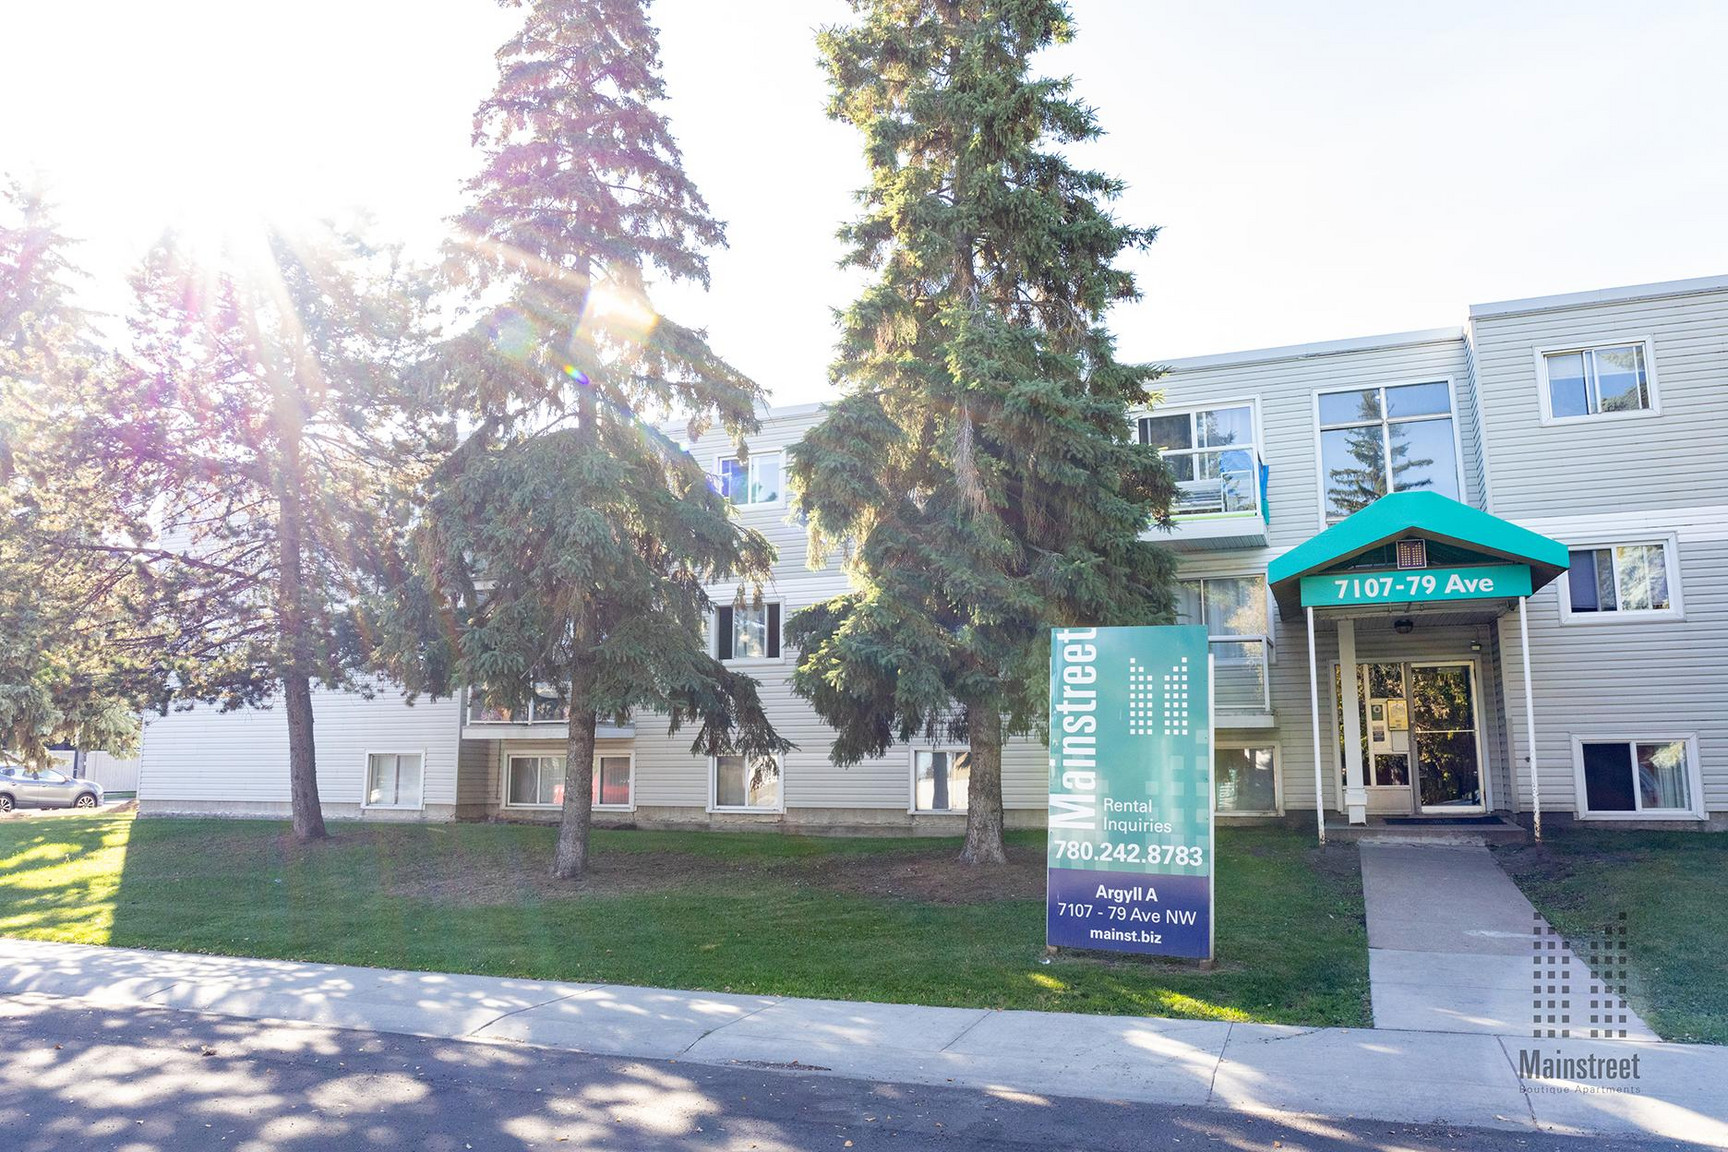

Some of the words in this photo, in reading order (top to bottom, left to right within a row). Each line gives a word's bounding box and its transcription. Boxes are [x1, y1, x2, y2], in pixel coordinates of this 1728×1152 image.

[1334, 575, 1437, 600] 7107-79
[1444, 573, 1495, 594] Ave
[1048, 627, 1098, 831] Mainstreet
[1103, 797, 1153, 813] Rental
[1103, 816, 1173, 835] Inquiries
[1054, 840, 1204, 867] 780.242.8783
[1095, 884, 1142, 904] Argyll
[1145, 887, 1159, 902] A
[1057, 902, 1094, 919] 7107
[1107, 906, 1127, 922] 79
[1129, 907, 1161, 924] Ave
[1166, 909, 1197, 926] NW
[1089, 927, 1162, 944] mainst.biz
